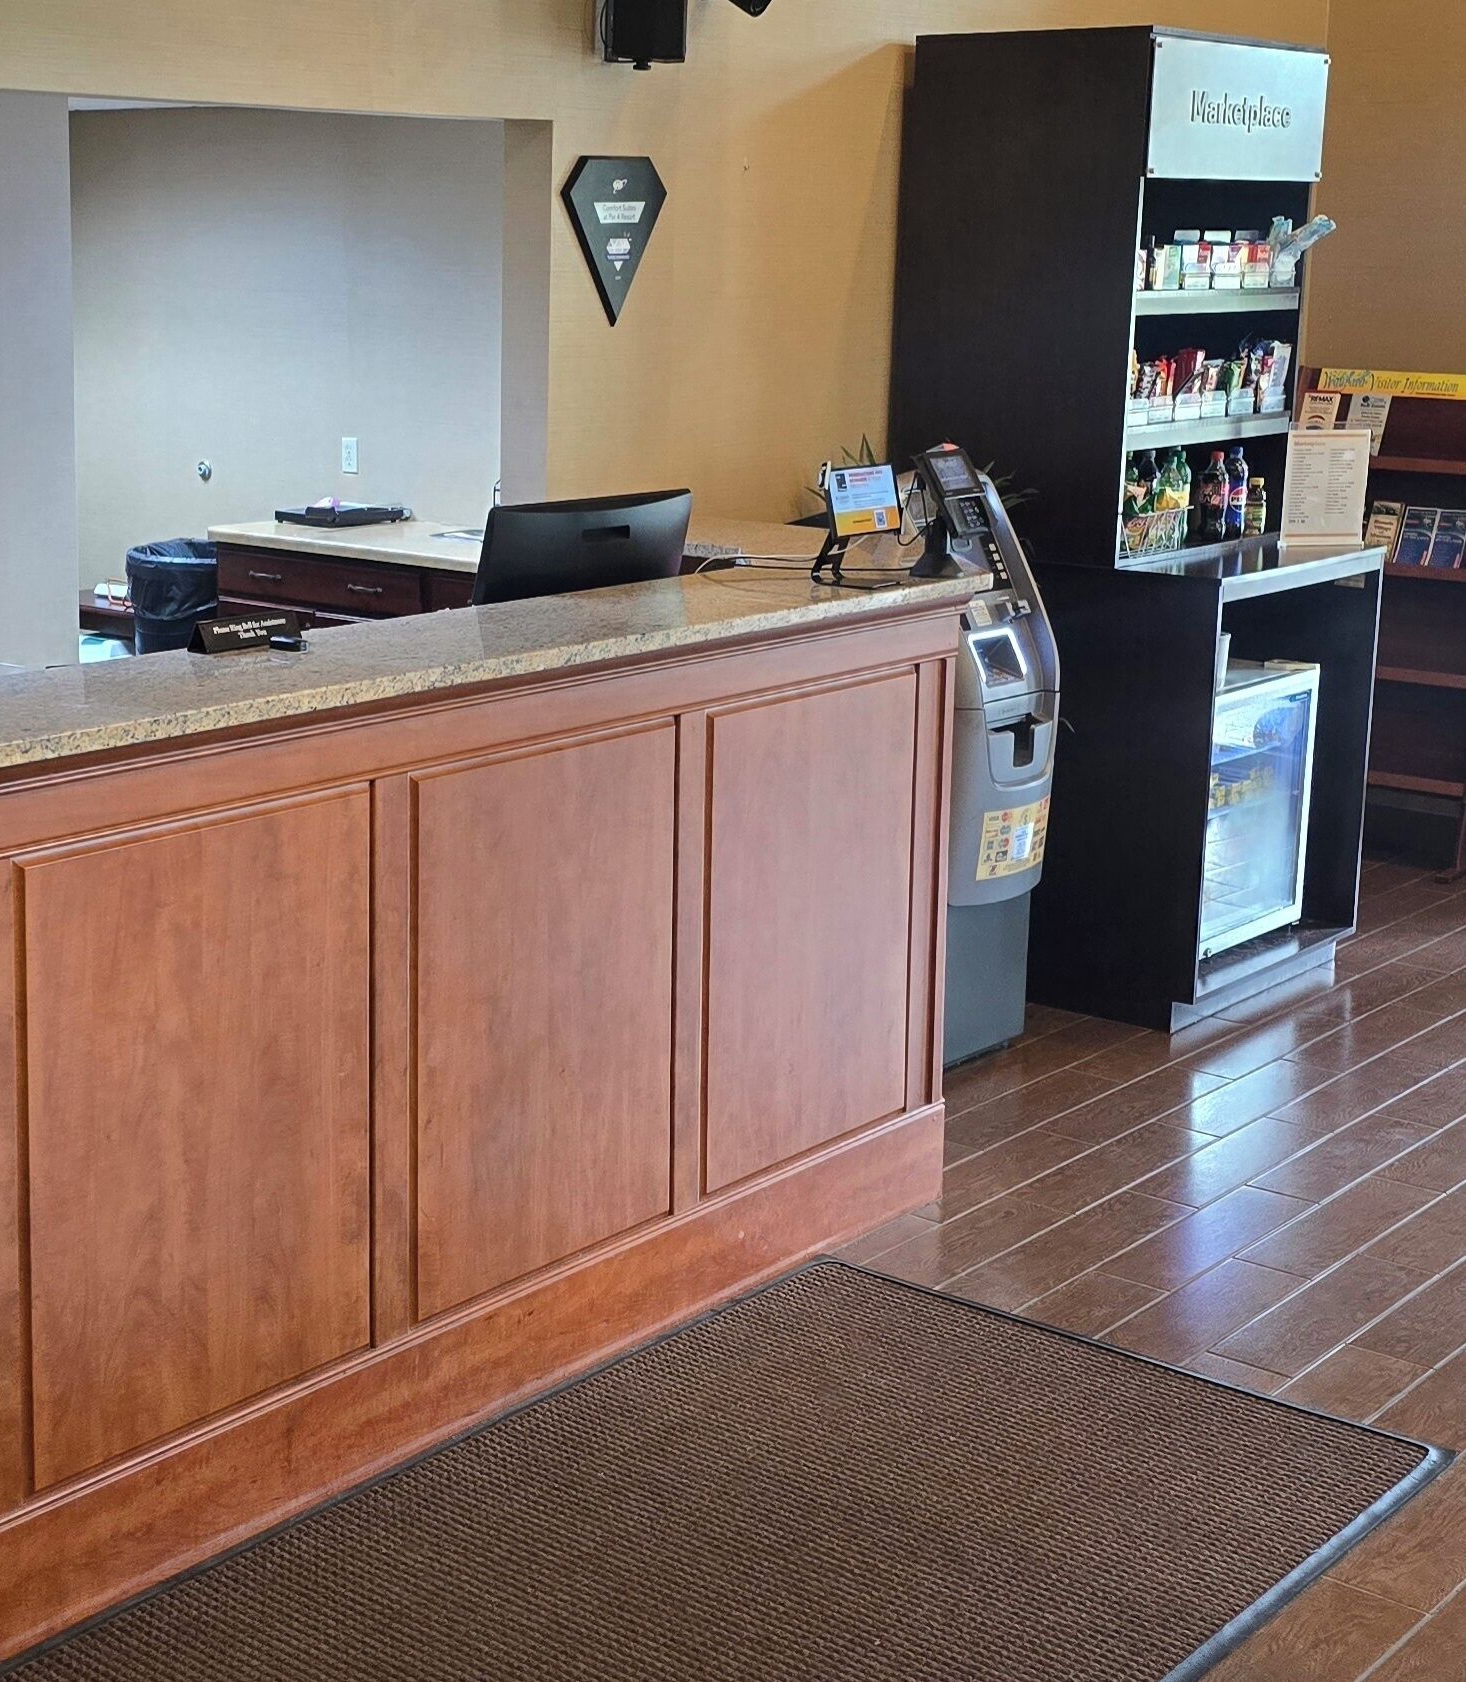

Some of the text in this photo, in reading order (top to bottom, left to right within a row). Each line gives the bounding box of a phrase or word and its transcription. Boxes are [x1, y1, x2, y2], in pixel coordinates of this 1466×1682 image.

[1190, 90, 1291, 133] Marketplace
[1370, 372, 1402, 391] Visitor
[1401, 376, 1459, 394] Information
